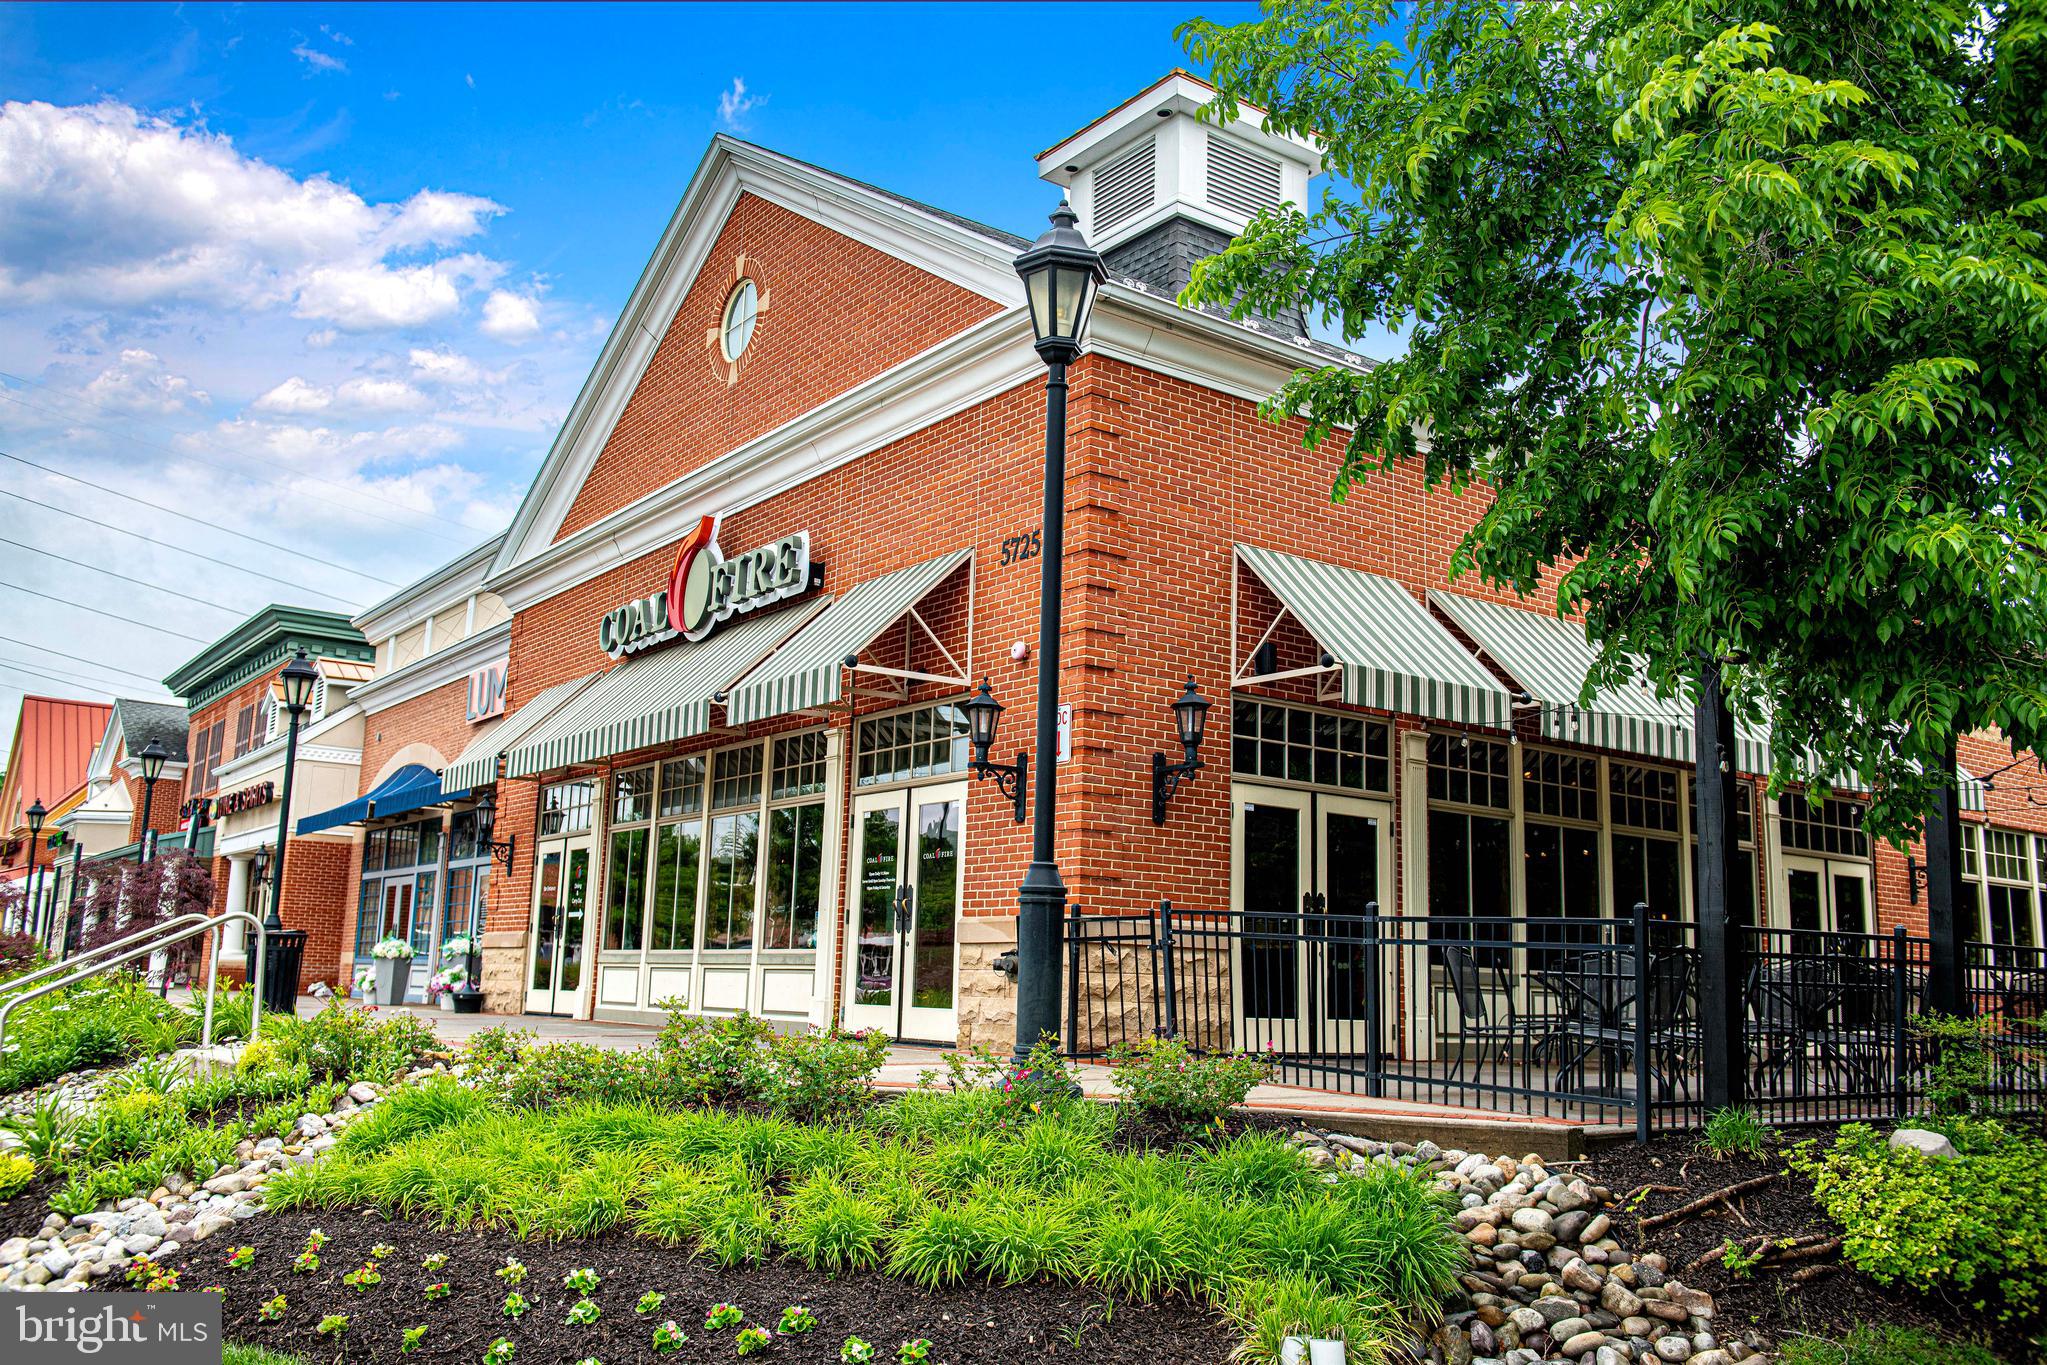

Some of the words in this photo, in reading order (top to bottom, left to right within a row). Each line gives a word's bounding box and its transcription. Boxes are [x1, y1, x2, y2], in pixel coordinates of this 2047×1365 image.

[1000, 529, 1041, 567] 5725
[599, 590, 671, 653] COAL
[708, 534, 802, 613] FIRE
[466, 666, 508, 721] LUM
[241, 781, 270, 812] SPIRITS
